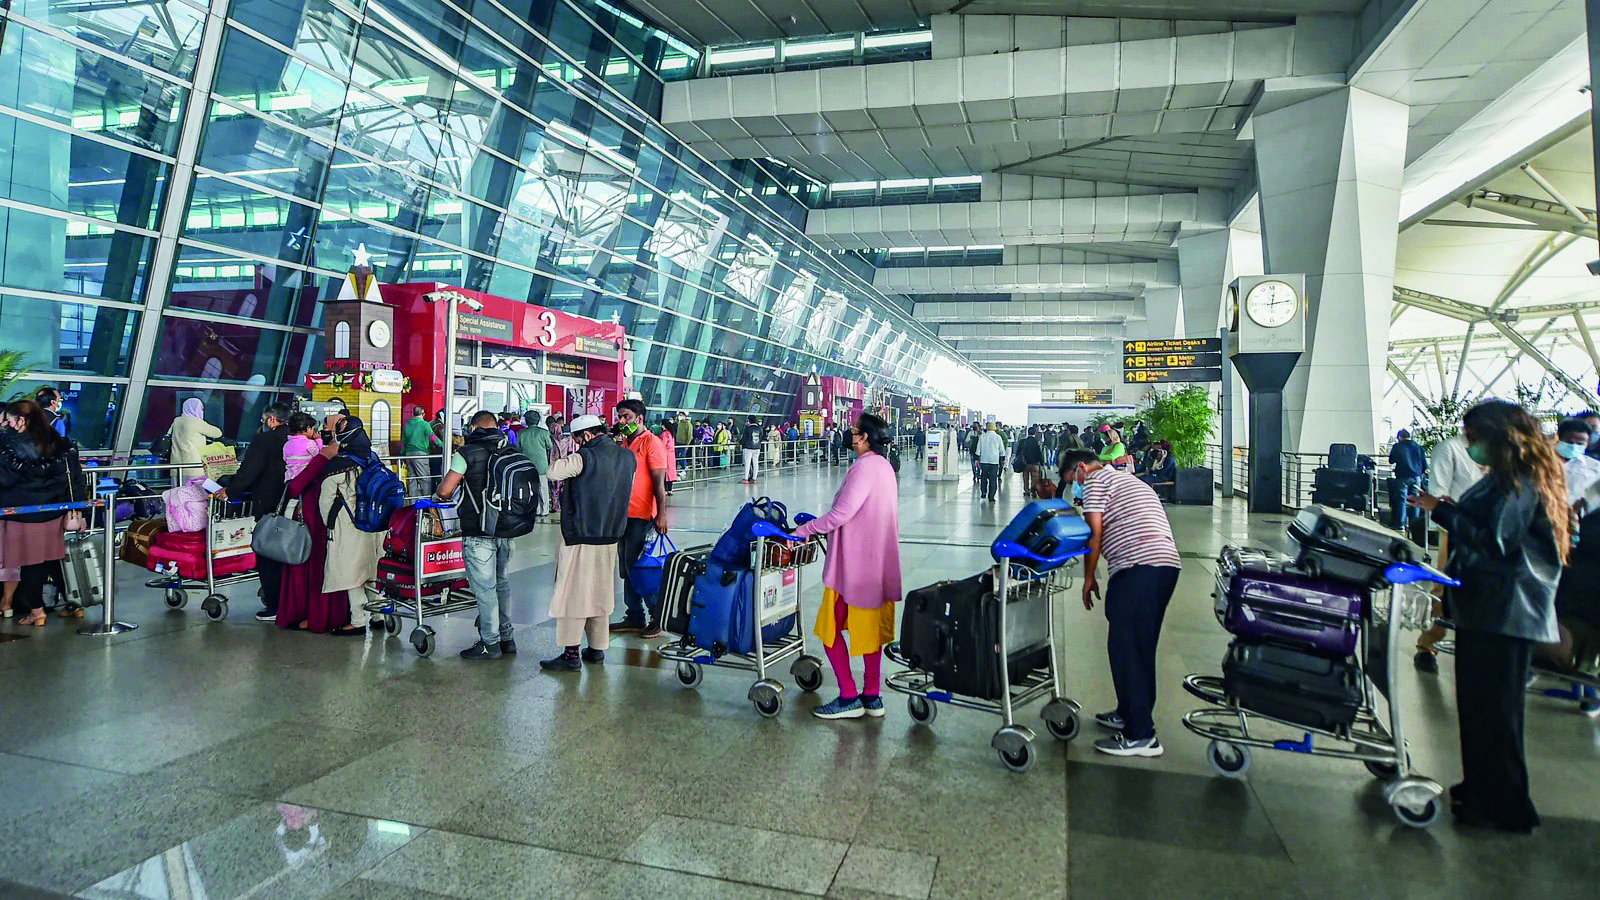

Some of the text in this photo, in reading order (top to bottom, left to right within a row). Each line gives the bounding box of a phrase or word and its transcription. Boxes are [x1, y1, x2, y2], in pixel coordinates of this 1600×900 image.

[459, 314, 478, 326] Special
[480, 318, 506, 330] Assistance
[539, 311, 556, 347] 3
